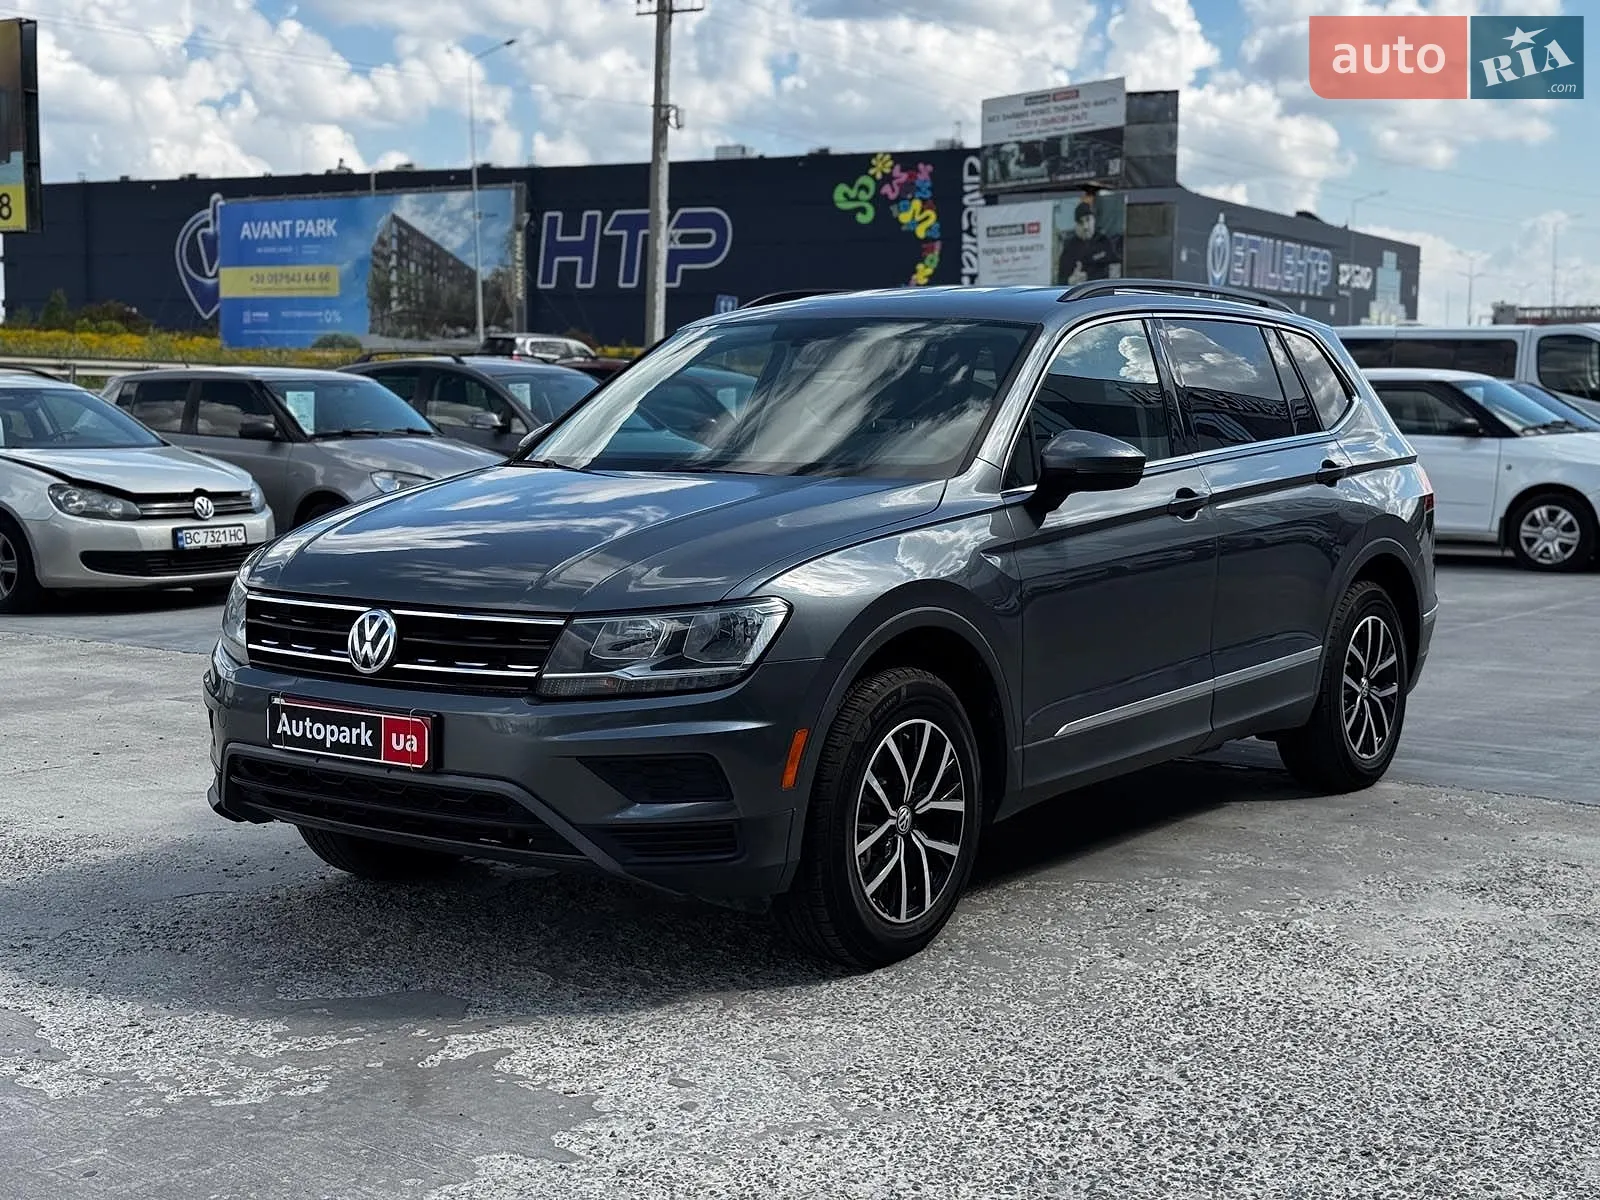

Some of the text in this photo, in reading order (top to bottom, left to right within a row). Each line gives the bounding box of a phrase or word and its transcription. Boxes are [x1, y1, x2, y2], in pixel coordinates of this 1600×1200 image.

[240, 217, 338, 241] AVANT PARK
[184, 528, 243, 545] BC 7321 HC
[276, 712, 418, 753] Autopark ua
